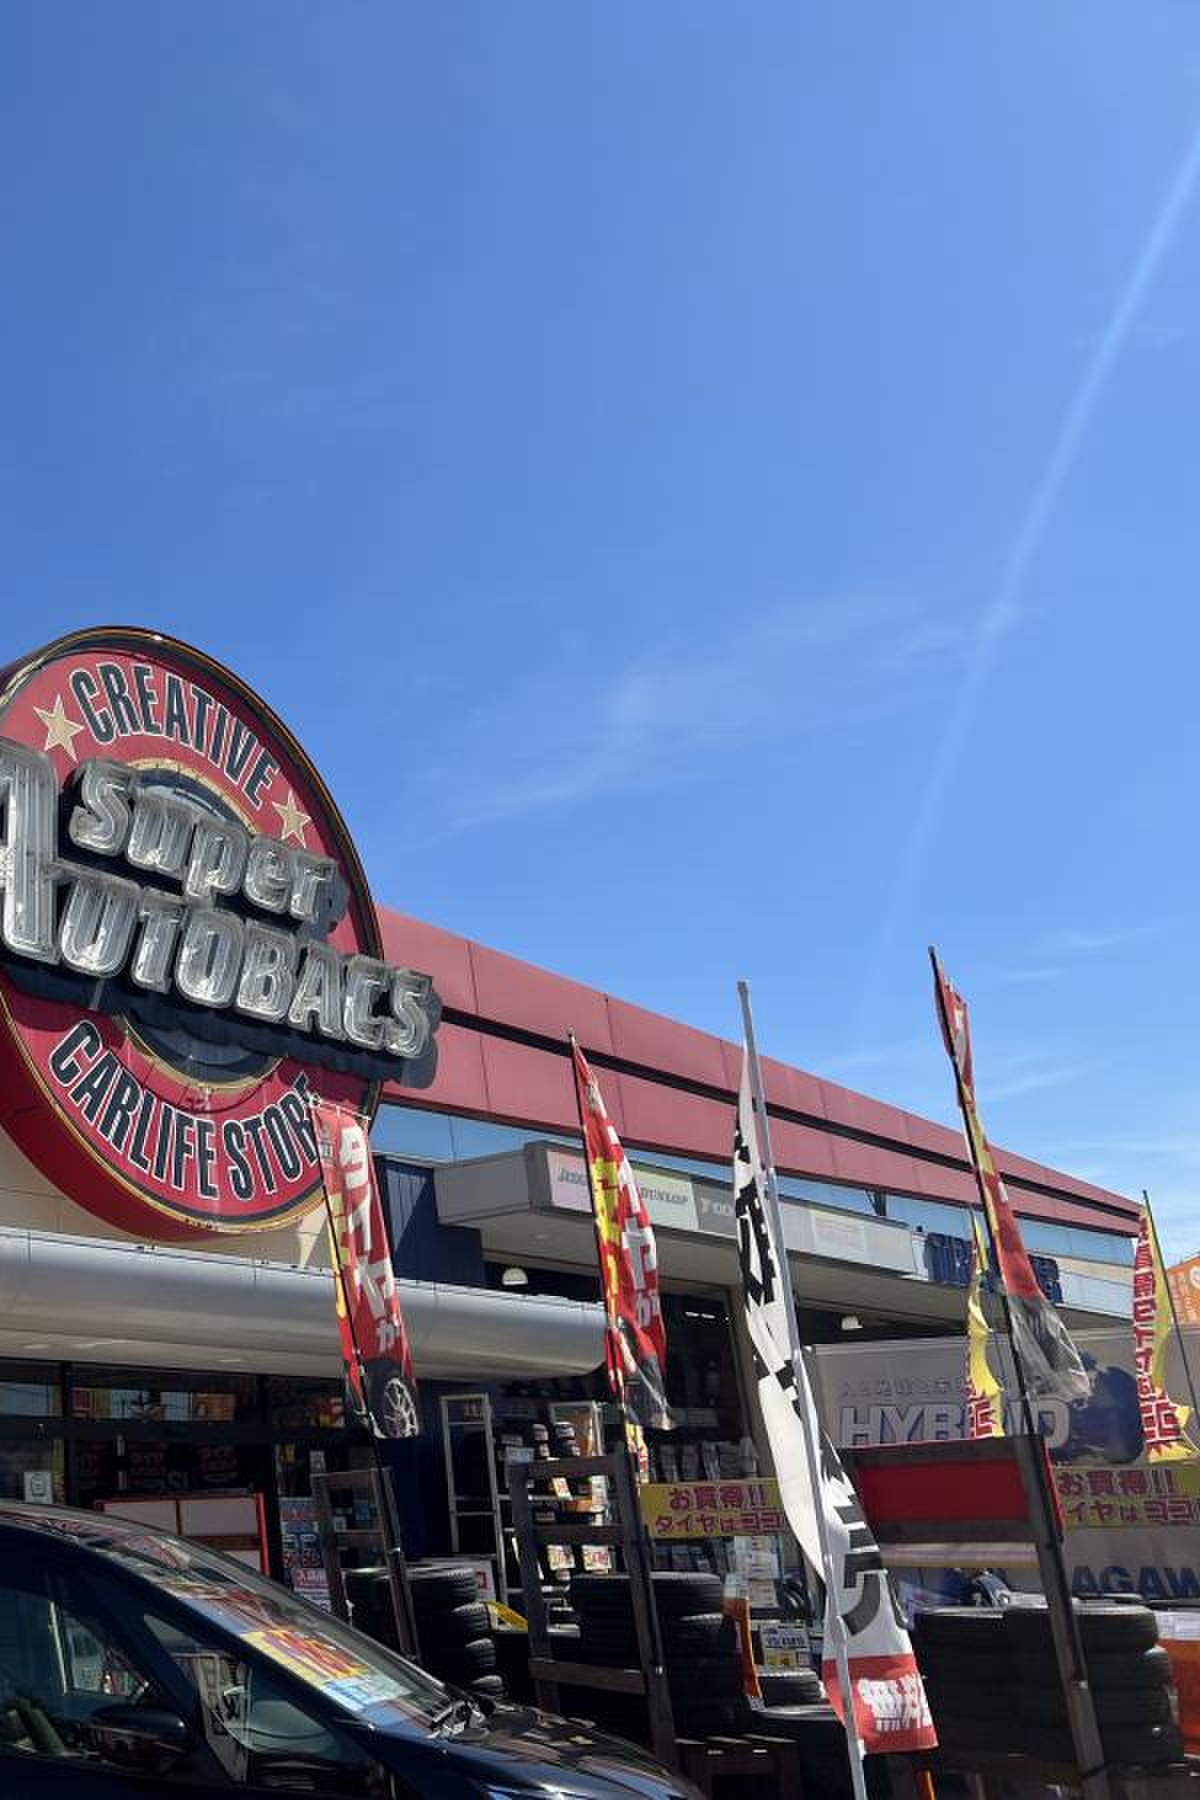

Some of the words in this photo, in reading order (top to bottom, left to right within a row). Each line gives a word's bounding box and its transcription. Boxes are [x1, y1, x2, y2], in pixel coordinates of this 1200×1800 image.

[69, 662, 280, 809] CREATIVE
[48, 1019, 218, 1200] CARLIFE
[222, 1072, 326, 1202] STOR
[841, 1399, 1071, 1448] HYBID
